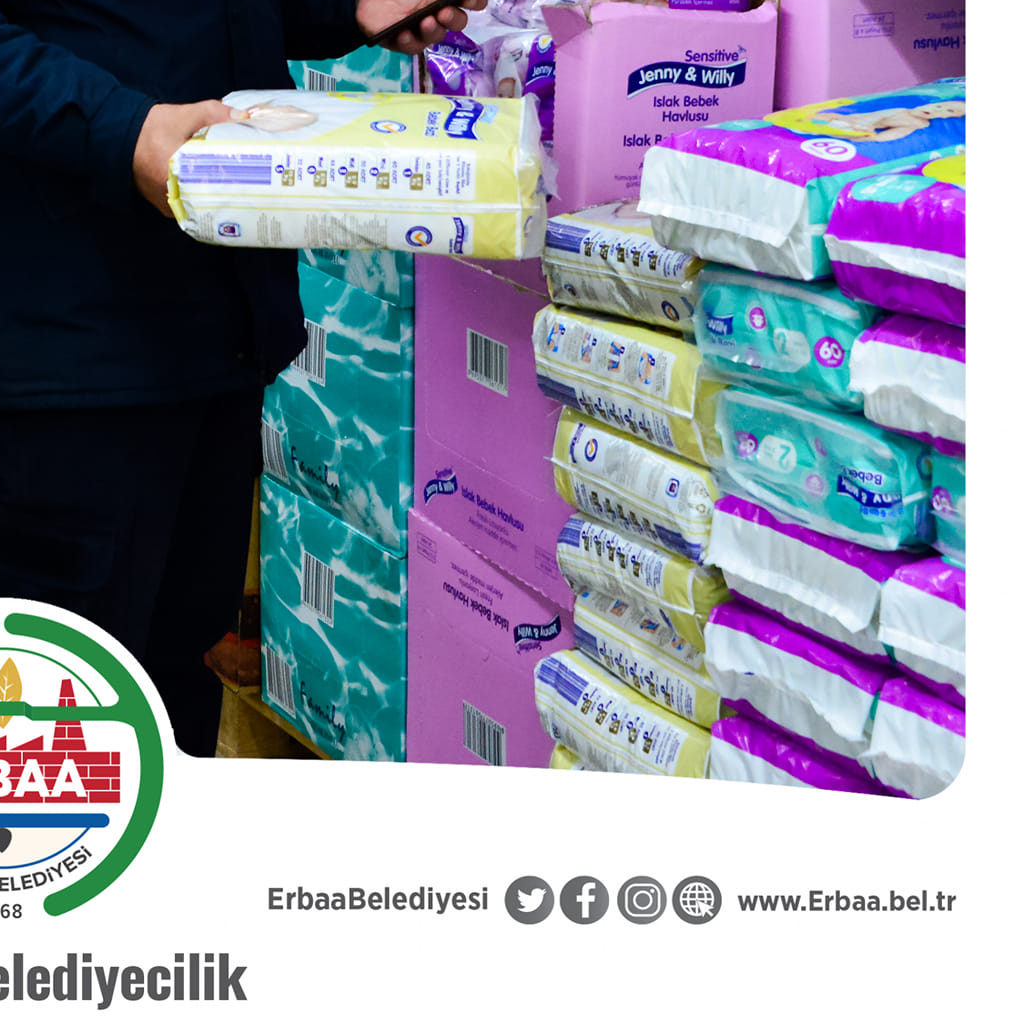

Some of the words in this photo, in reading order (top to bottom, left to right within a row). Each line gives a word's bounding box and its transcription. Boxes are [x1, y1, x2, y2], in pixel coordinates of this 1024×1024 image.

[913, 36, 960, 51] Havlusu
[685, 49, 740, 62] Sensitive
[532, 63, 553, 76] Jenny
[638, 67, 682, 85] Jenny
[684, 66, 697, 82] &
[701, 69, 735, 87] Willy
[653, 96, 680, 108] Islak
[683, 94, 720, 107] Bebek
[662, 110, 709, 123] Havlusu
[623, 134, 652, 147] Islak
[819, 342, 842, 359] 60
[290, 445, 340, 501] Family
[442, 581, 470, 609] Havlusu
[470, 598, 492, 622] Bebek
[492, 612, 510, 633] Islak
[300, 680, 346, 743] Family
